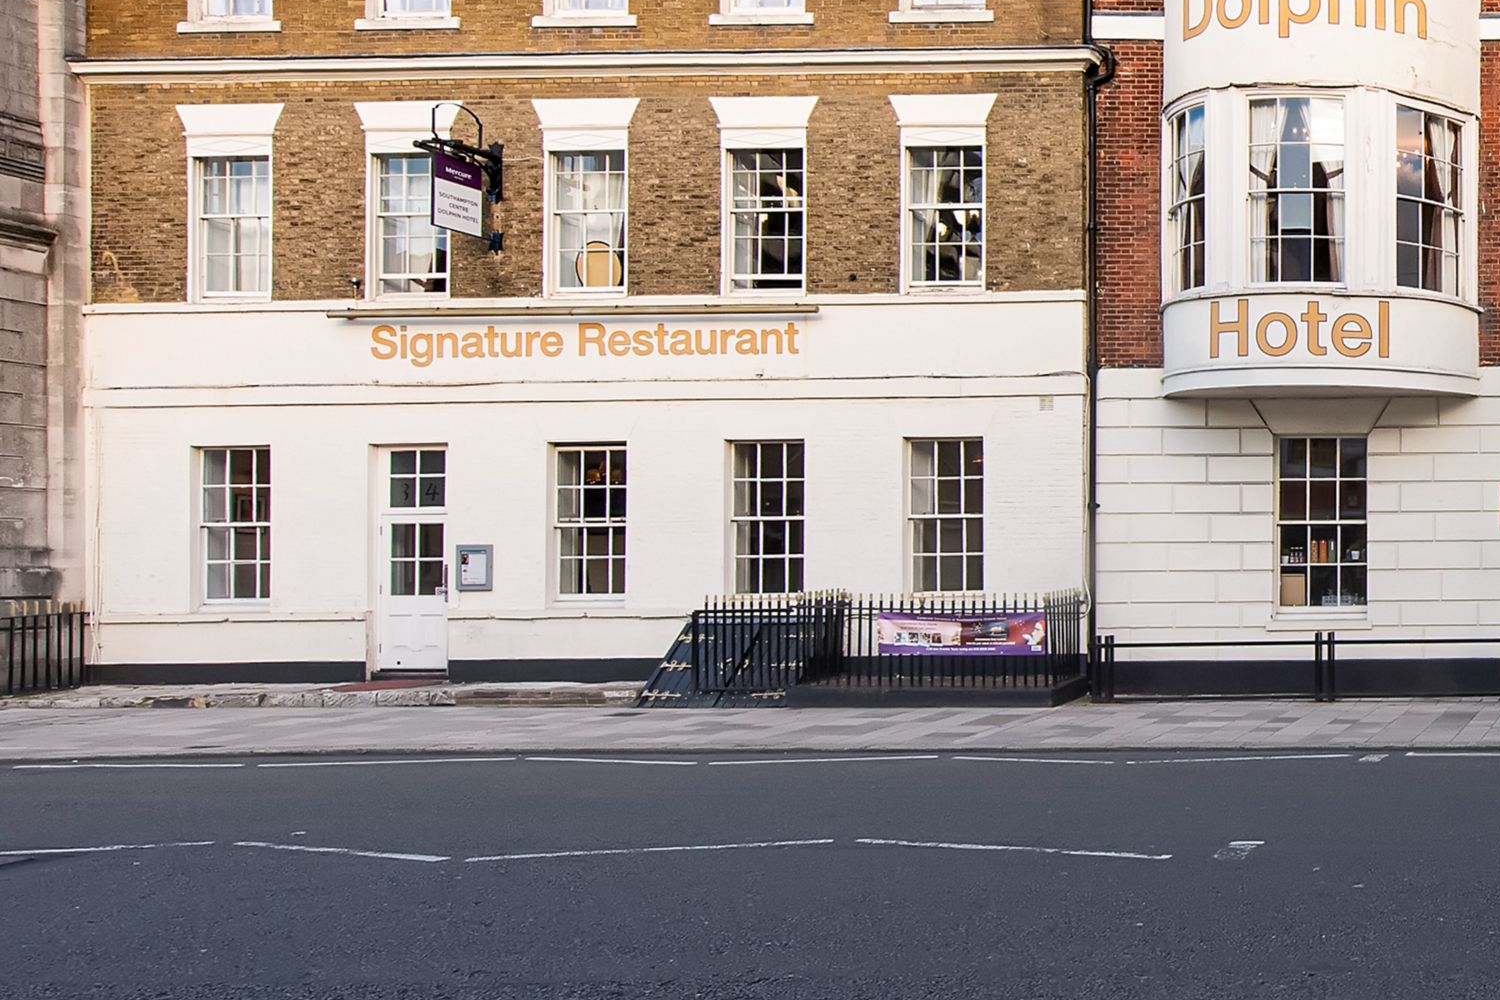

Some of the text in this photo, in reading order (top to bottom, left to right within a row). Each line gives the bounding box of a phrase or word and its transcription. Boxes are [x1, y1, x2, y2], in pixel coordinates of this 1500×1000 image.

[445, 166, 472, 179] Mercure
[439, 191, 479, 207] SOUTHAMPTON
[437, 207, 479, 224] DOLPHIN HOTEL
[448, 202, 469, 213] CENTRE
[1209, 298, 1390, 359] Hotel
[371, 322, 800, 367] Signature Restaurant
